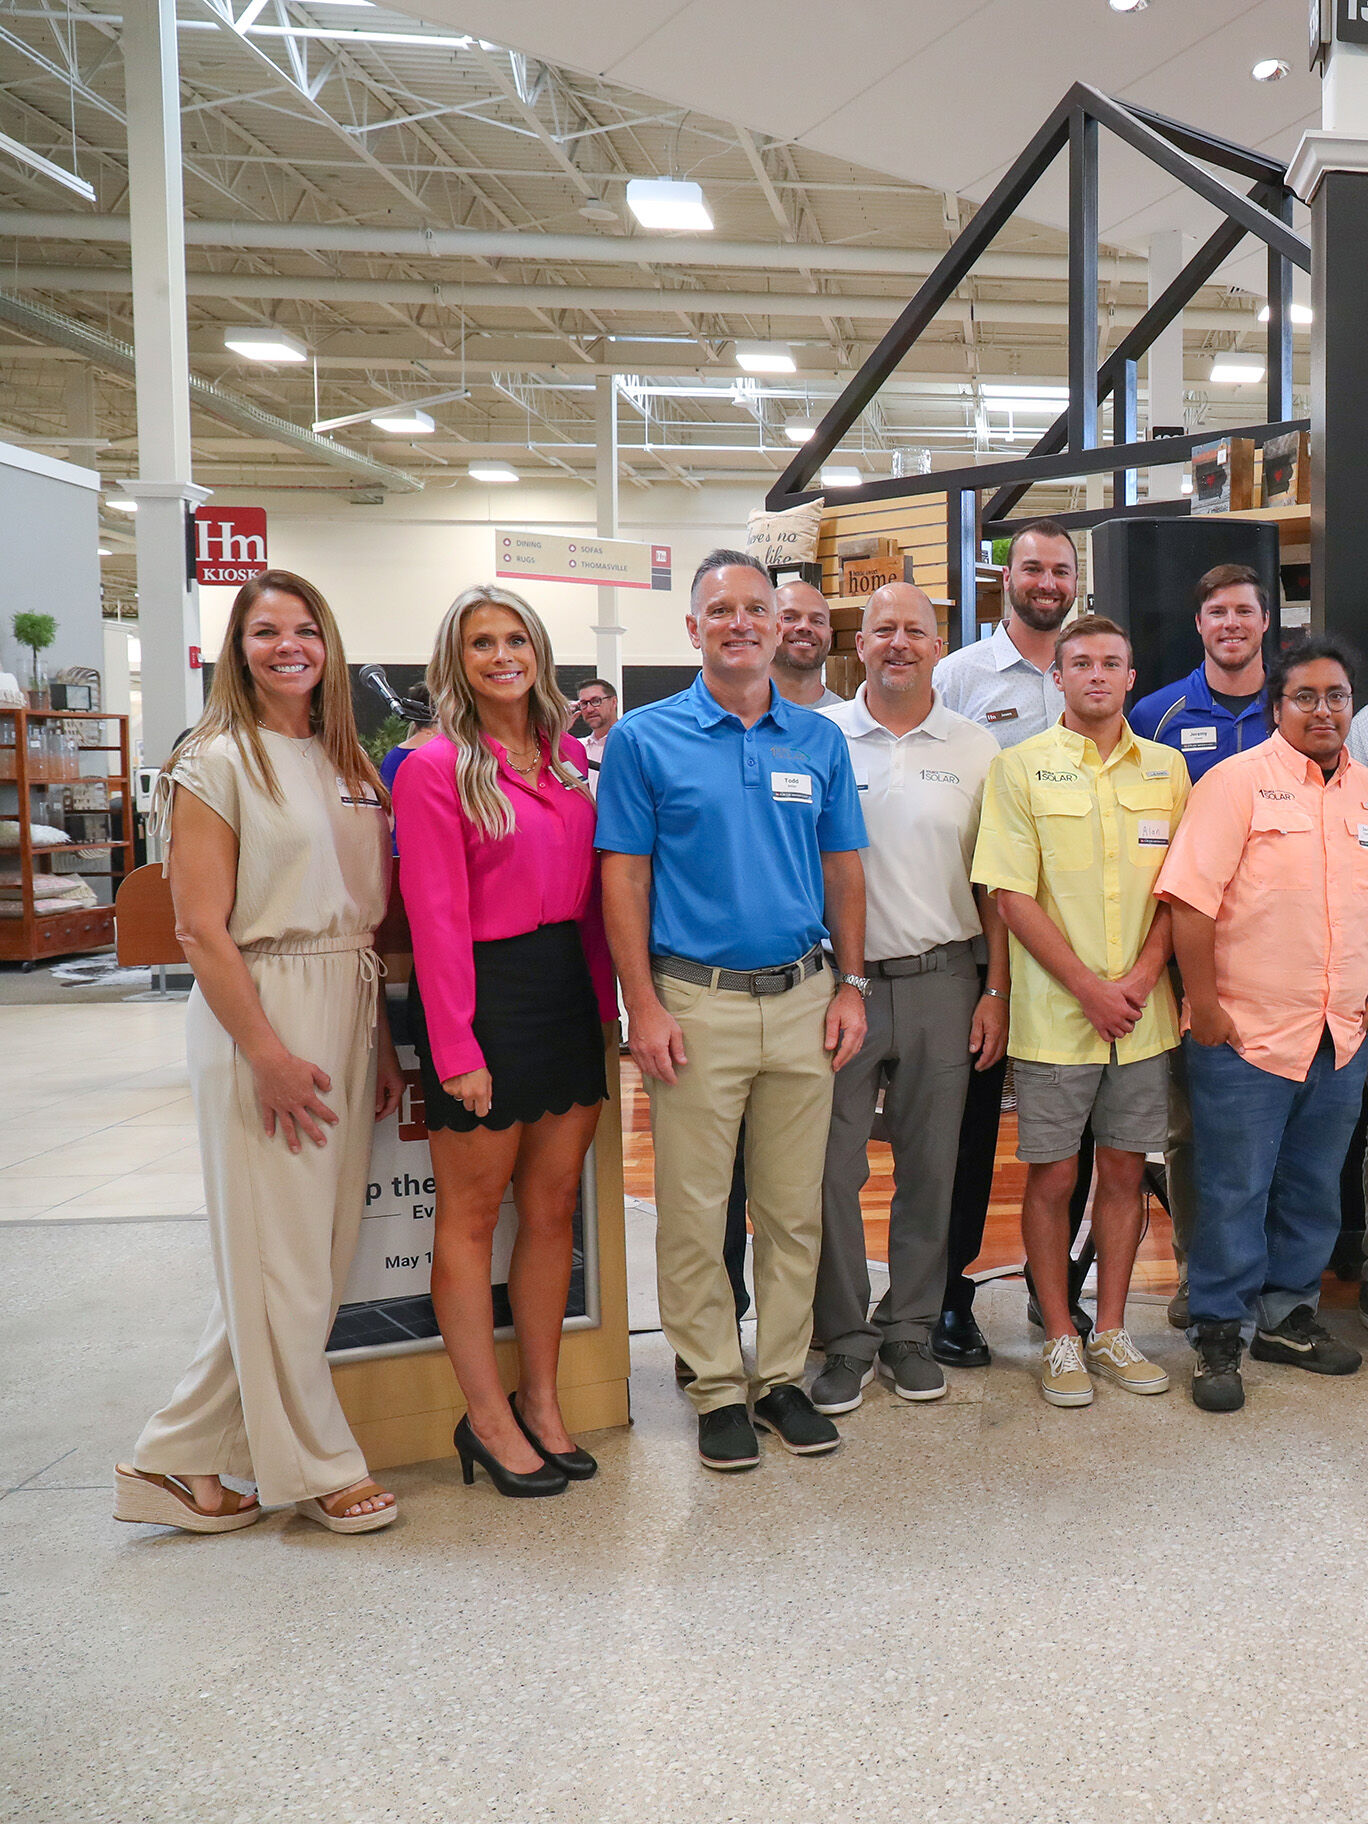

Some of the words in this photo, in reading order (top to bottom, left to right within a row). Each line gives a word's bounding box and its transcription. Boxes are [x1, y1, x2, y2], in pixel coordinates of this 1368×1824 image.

[194, 520, 267, 563] Hm
[777, 532, 798, 543] no
[516, 539, 542, 549] DINING
[580, 545, 603, 555] SOFAS
[765, 545, 792, 565] like
[516, 555, 536, 564] RUGS
[580, 561, 628, 572] THOMASVILLE
[202, 567, 260, 582] KIOSK
[848, 570, 897, 593] home
[925, 773, 956, 784] SOLAR
[1042, 774, 1073, 783] SOLAR
[1264, 793, 1291, 801] SOLAR
[391, 1173, 436, 1198] the
[385, 1255, 419, 1269] May
